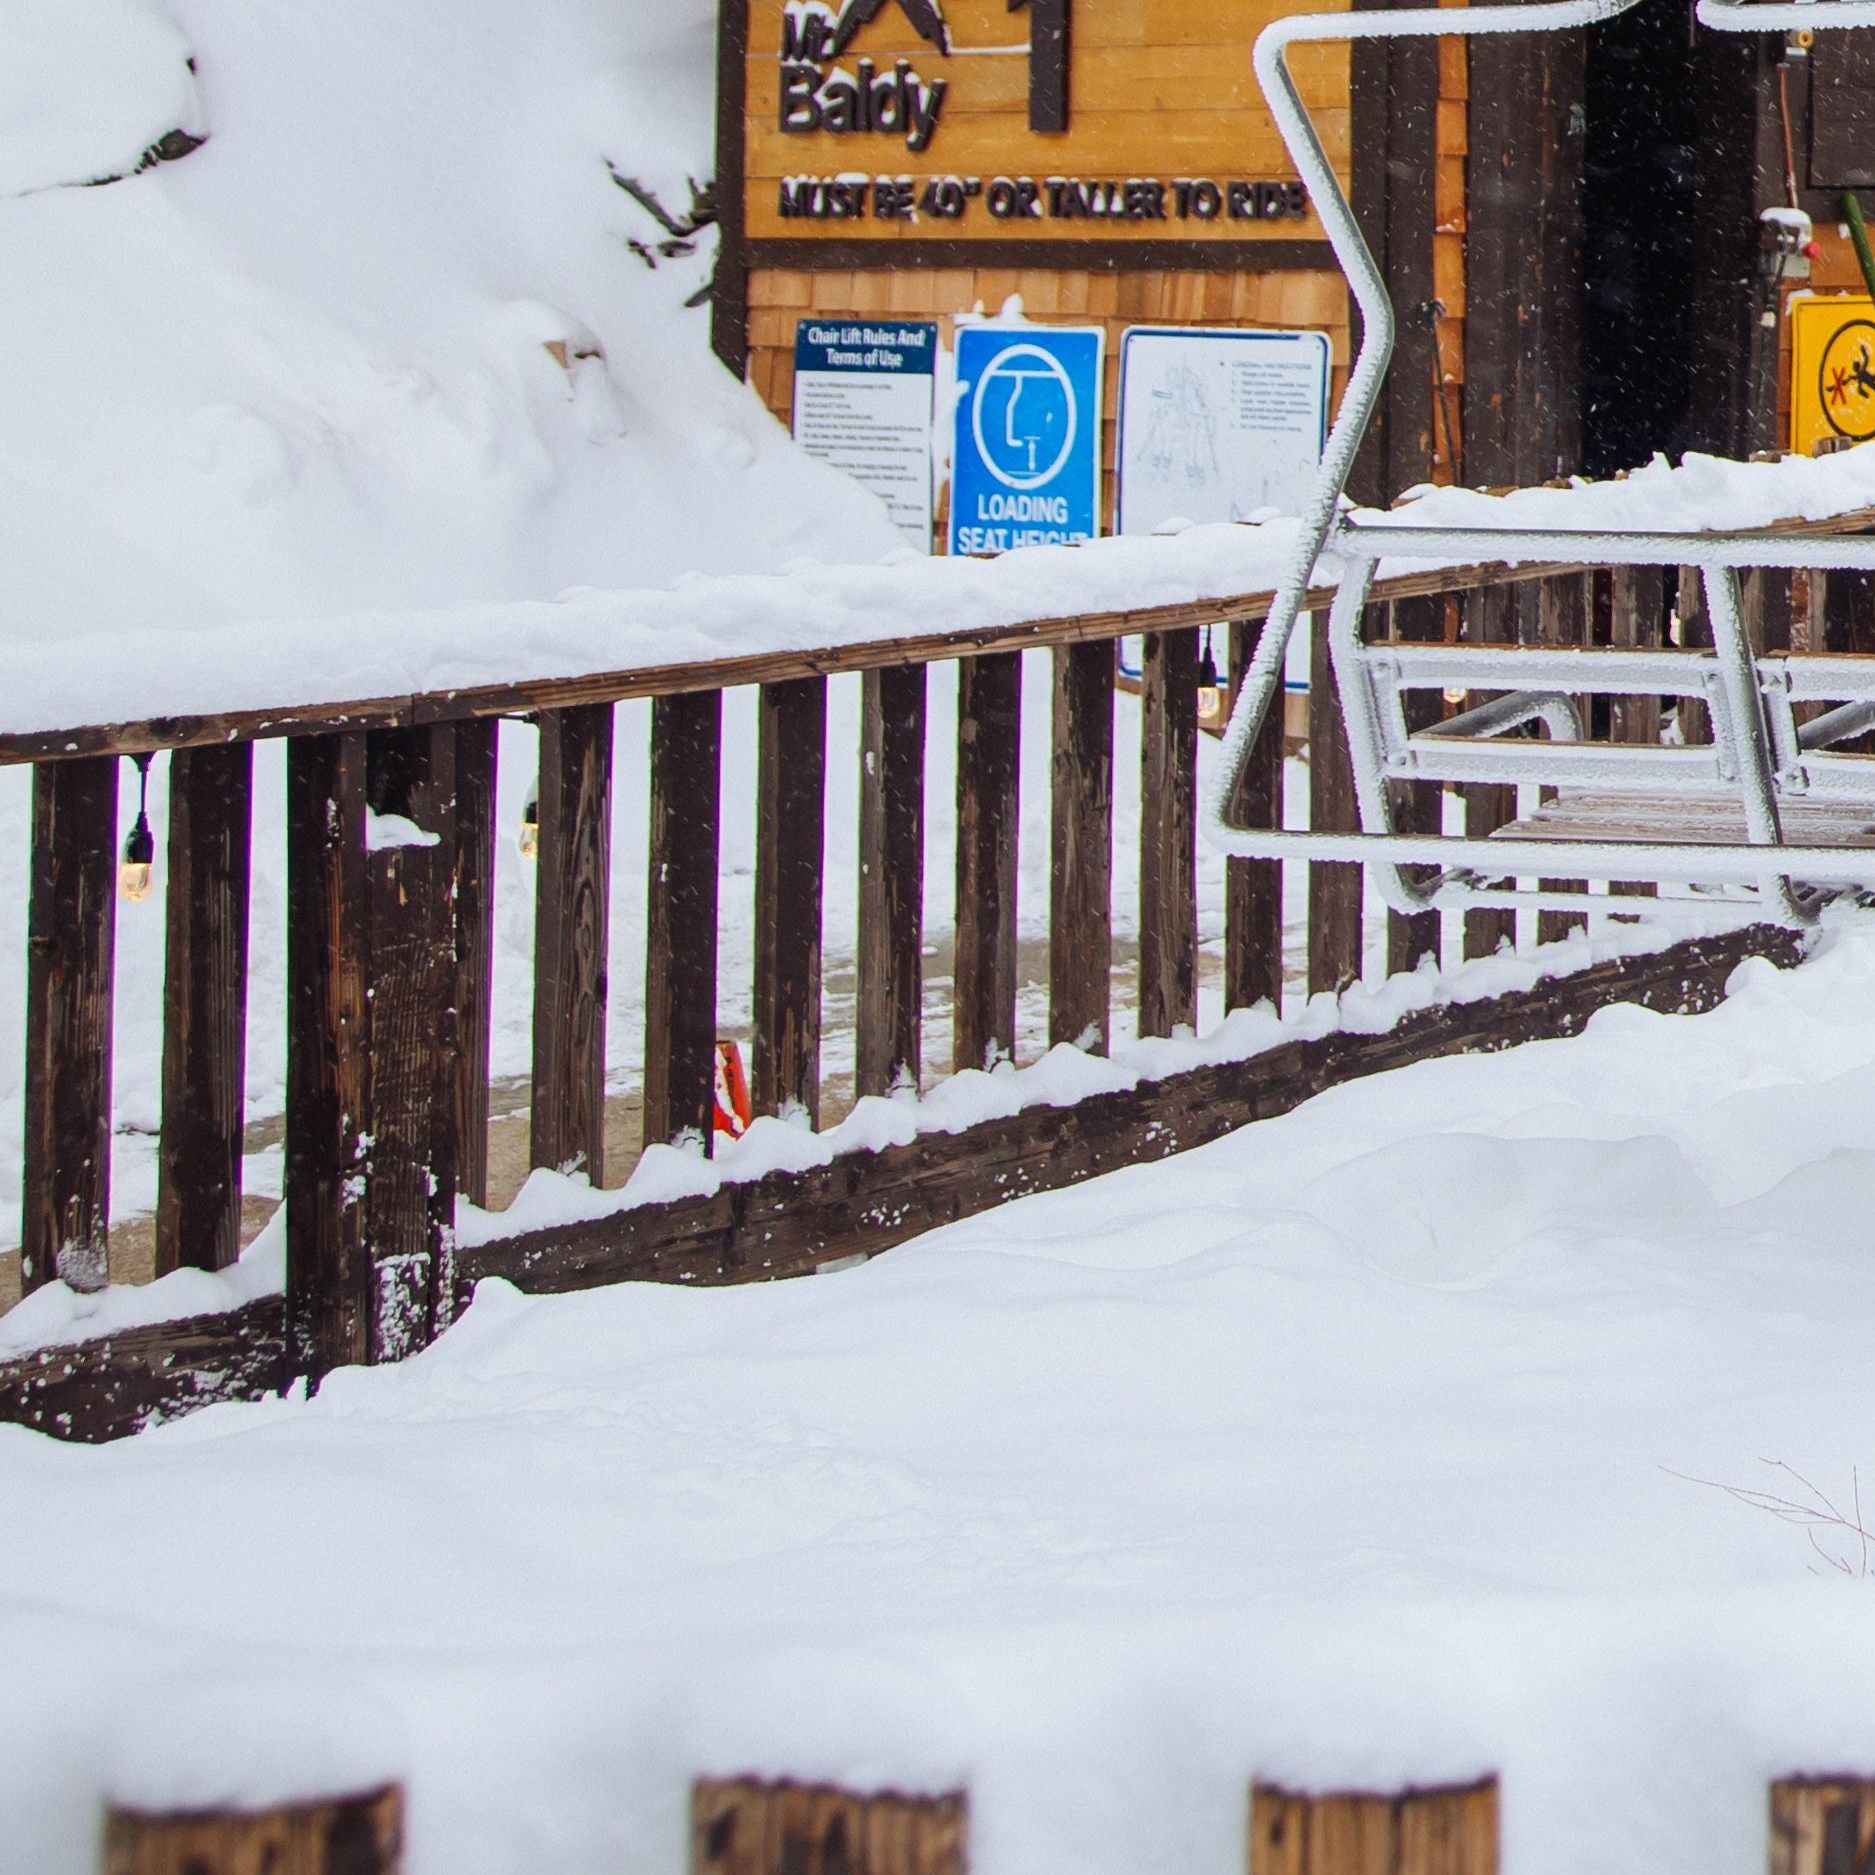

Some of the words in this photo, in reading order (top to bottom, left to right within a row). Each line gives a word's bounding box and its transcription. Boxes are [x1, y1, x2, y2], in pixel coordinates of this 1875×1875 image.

[779, 57, 948, 153] Baldy
[778, 173, 871, 219] MUST
[872, 174, 914, 219] BE
[986, 176, 1041, 219] OR
[1043, 176, 1167, 219] TALLER
[1169, 178, 1221, 219] TO
[1227, 180, 1308, 220] RIDE
[808, 327, 840, 345] Chair
[840, 328, 861, 346] Lift
[863, 329, 896, 347] Rules
[897, 330, 926, 348] And
[826, 348, 862, 366] Terms
[863, 348, 878, 367] of
[879, 350, 904, 369] Use
[978, 494, 1069, 524] LOADING
[958, 526, 1009, 554] SEAT
